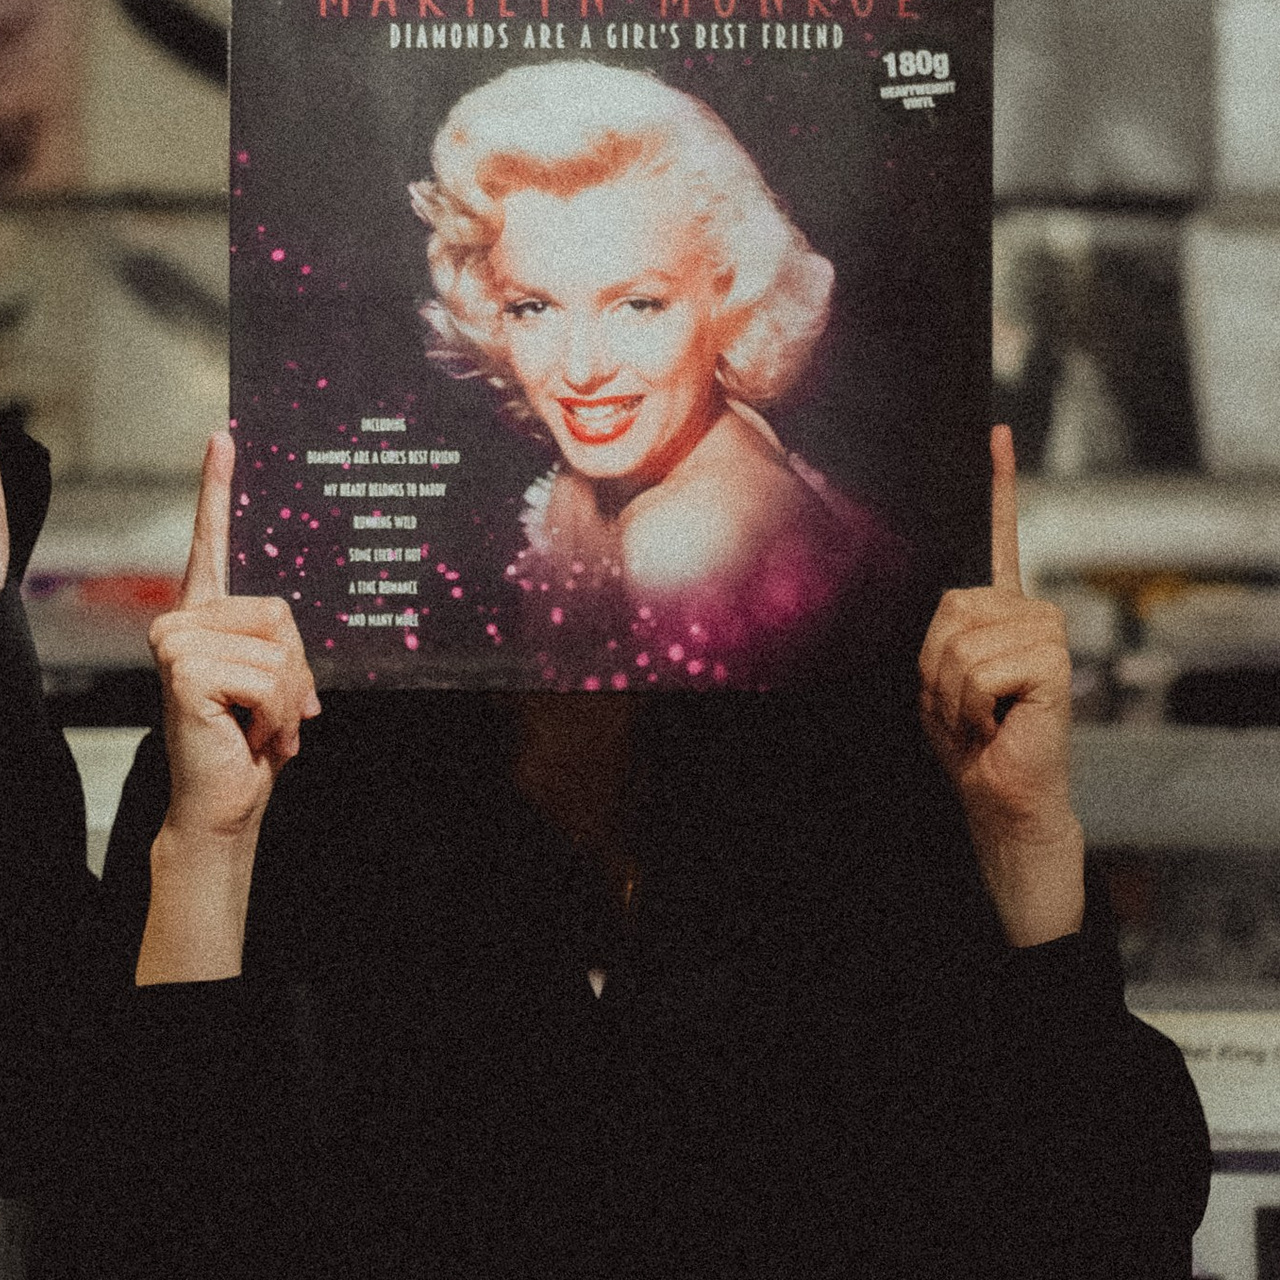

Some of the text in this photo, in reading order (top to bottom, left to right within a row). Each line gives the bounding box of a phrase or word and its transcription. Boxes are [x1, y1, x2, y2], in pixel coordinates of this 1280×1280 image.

[389, 22, 845, 51] DIAMONDS ARE A GIRL'S BEST FRIEND
[882, 49, 951, 80] 180g
